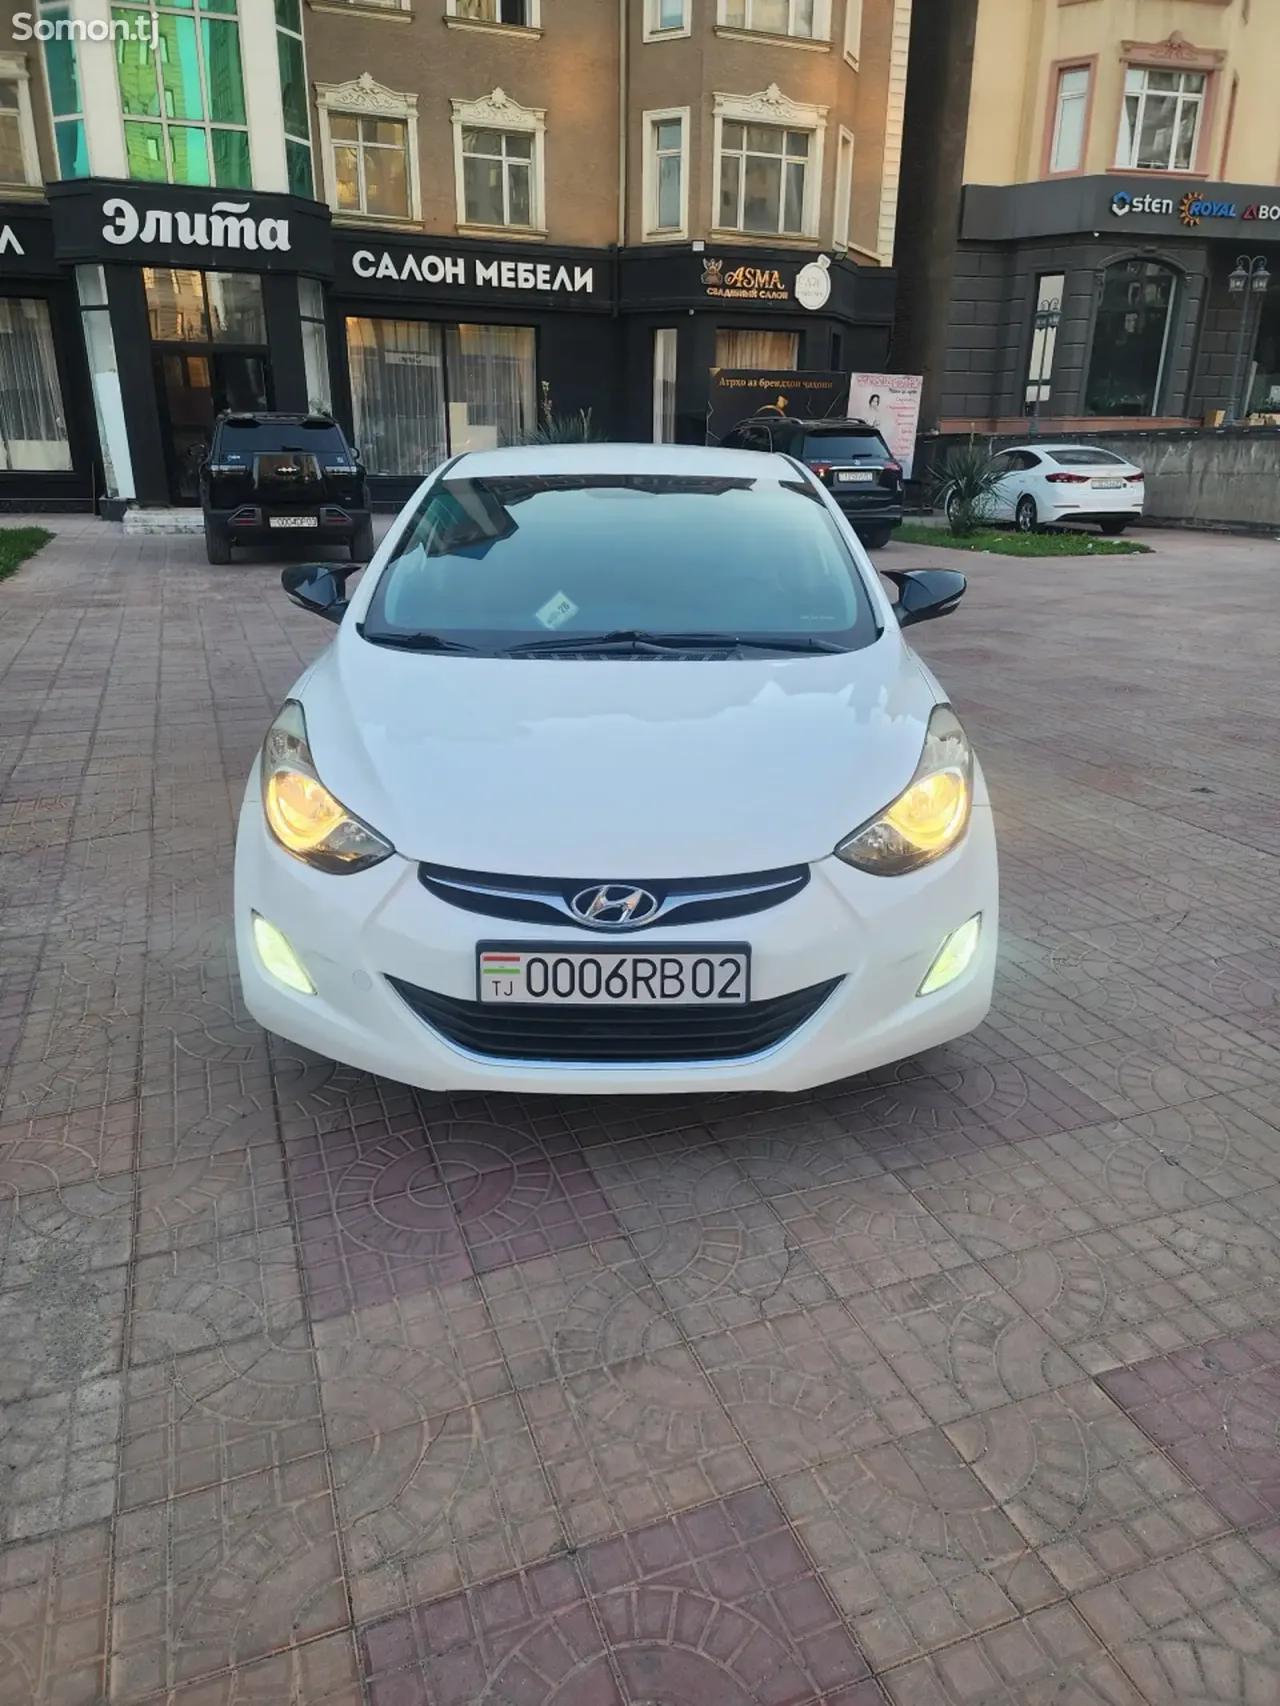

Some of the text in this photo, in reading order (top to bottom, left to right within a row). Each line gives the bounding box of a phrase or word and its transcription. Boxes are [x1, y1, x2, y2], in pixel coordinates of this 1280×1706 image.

[1189, 201, 1237, 217] ROYAL
[102, 198, 292, 252] Элита
[351, 250, 593, 293] САЛОН МЕБЕЛИ
[724, 266, 785, 290] ASMA
[758, 290, 788, 300] САЛОН
[492, 980, 514, 997] TJ
[525, 957, 742, 999] 0006RB02
